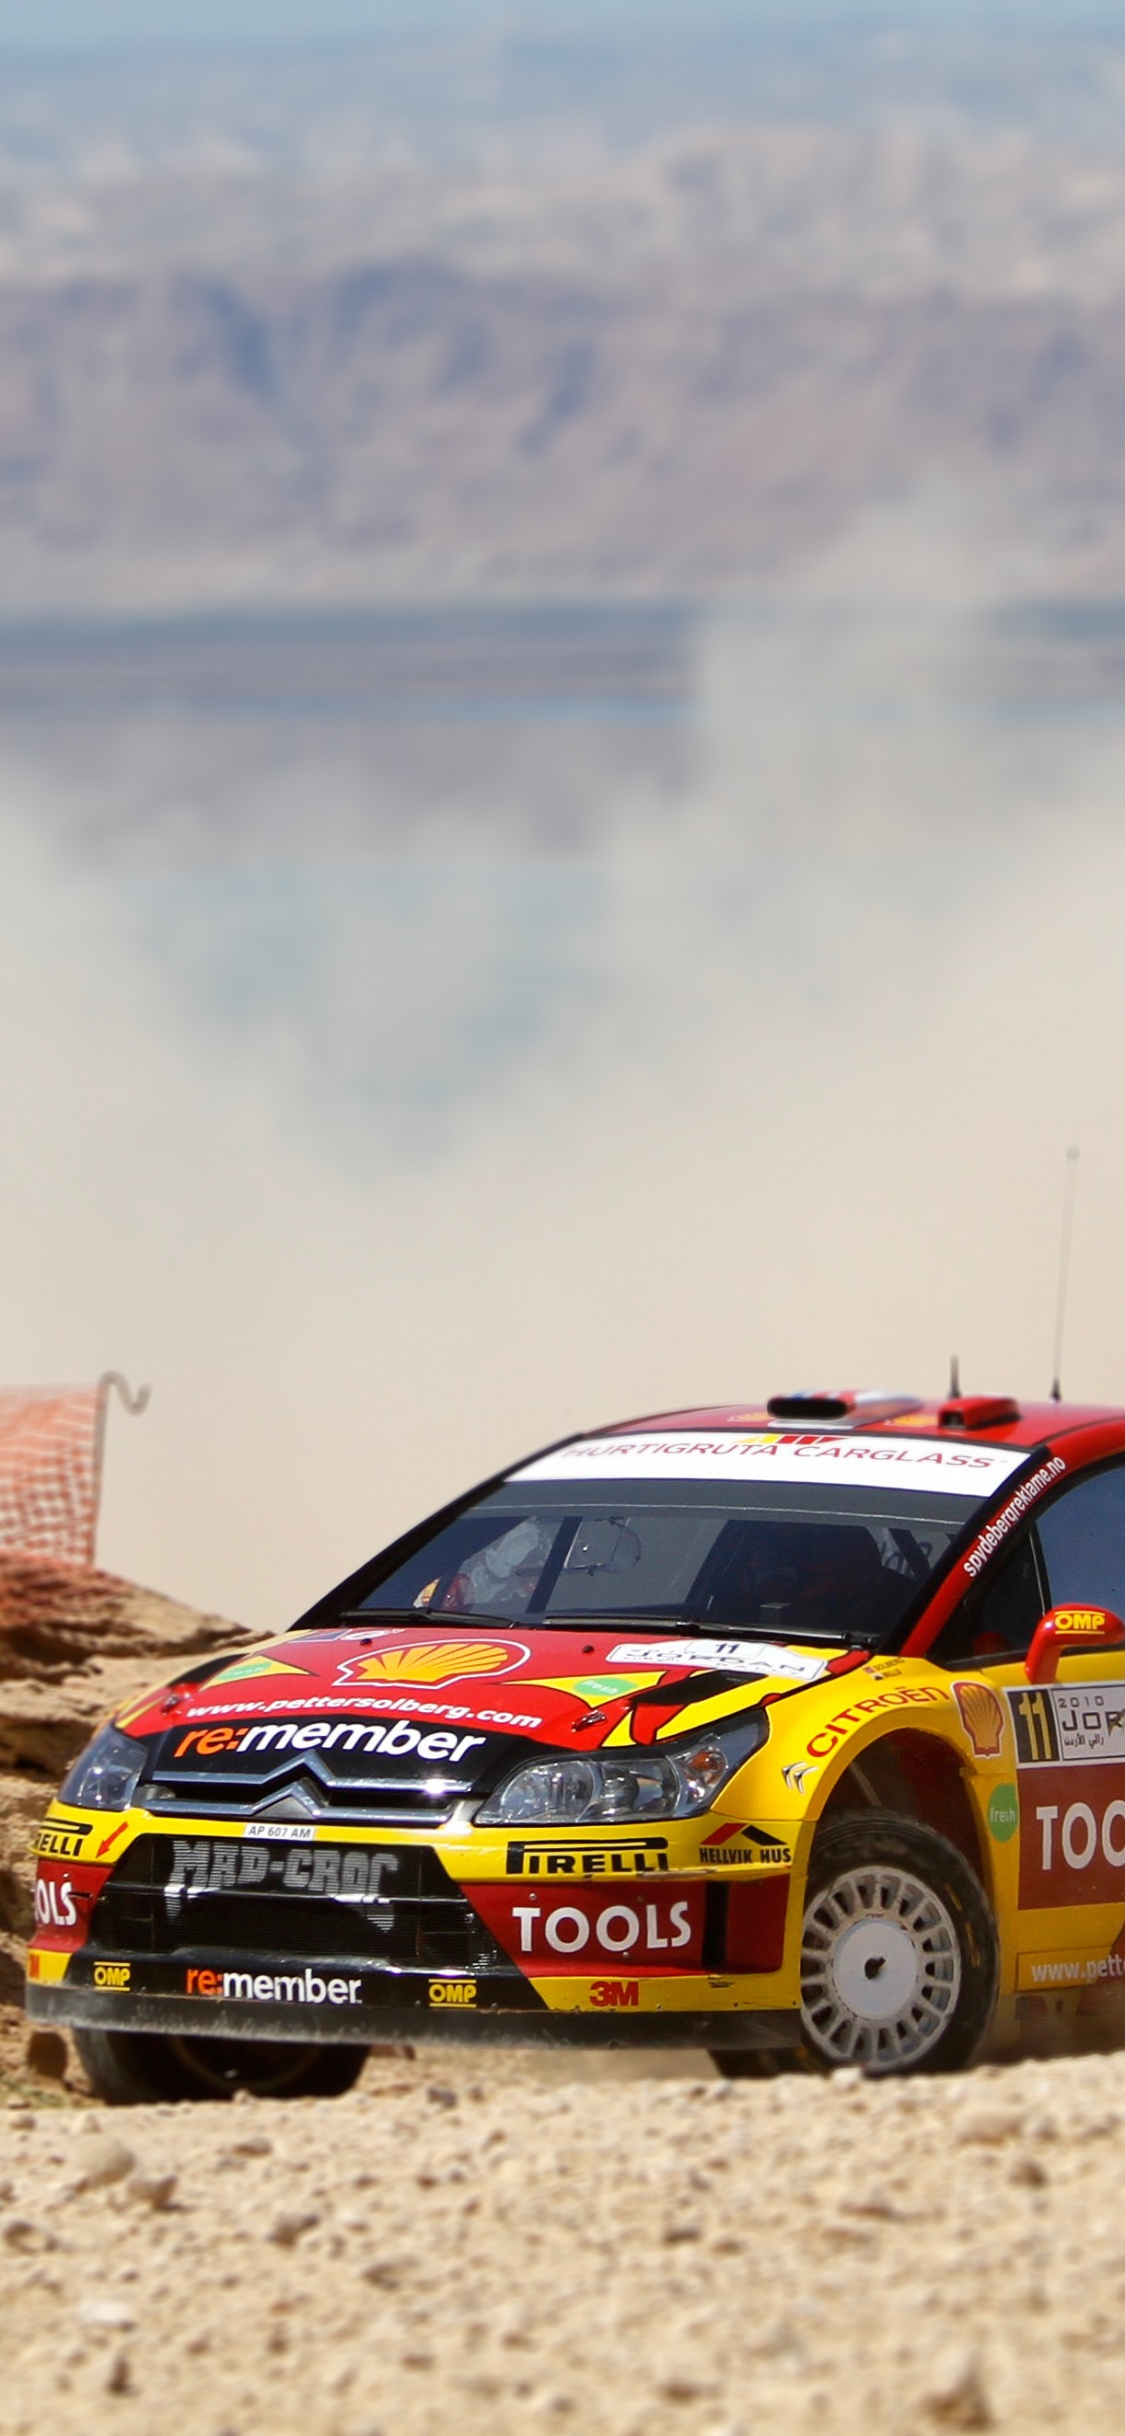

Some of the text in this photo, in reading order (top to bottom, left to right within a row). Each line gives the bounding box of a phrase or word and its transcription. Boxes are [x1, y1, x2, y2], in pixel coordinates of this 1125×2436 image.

[562, 1443, 996, 1468] HURTIGRUTA CARGLASS
[1054, 1613, 1105, 1631] OMP
[713, 1643, 741, 1654] 11
[186, 1695, 543, 1729] www.pettersolberg.com
[1058, 1695, 1104, 1709] 2010
[1018, 1691, 1052, 1760] 11
[174, 1719, 487, 1762] re:member
[989, 1806, 1016, 1823] fresh
[248, 1825, 311, 1839] AP 607 AM
[506, 1837, 669, 1875] PIRELLI
[699, 1847, 792, 1864] HELLVIK HUS
[34, 1878, 77, 1926] OLS
[512, 1901, 692, 1954] TOOLS
[94, 1966, 131, 1986] OMP
[1031, 1953, 1125, 1985] www.pett
[186, 1968, 363, 2005] re:member
[428, 1983, 477, 2003] OMP
[589, 1980, 639, 2007] 3M
